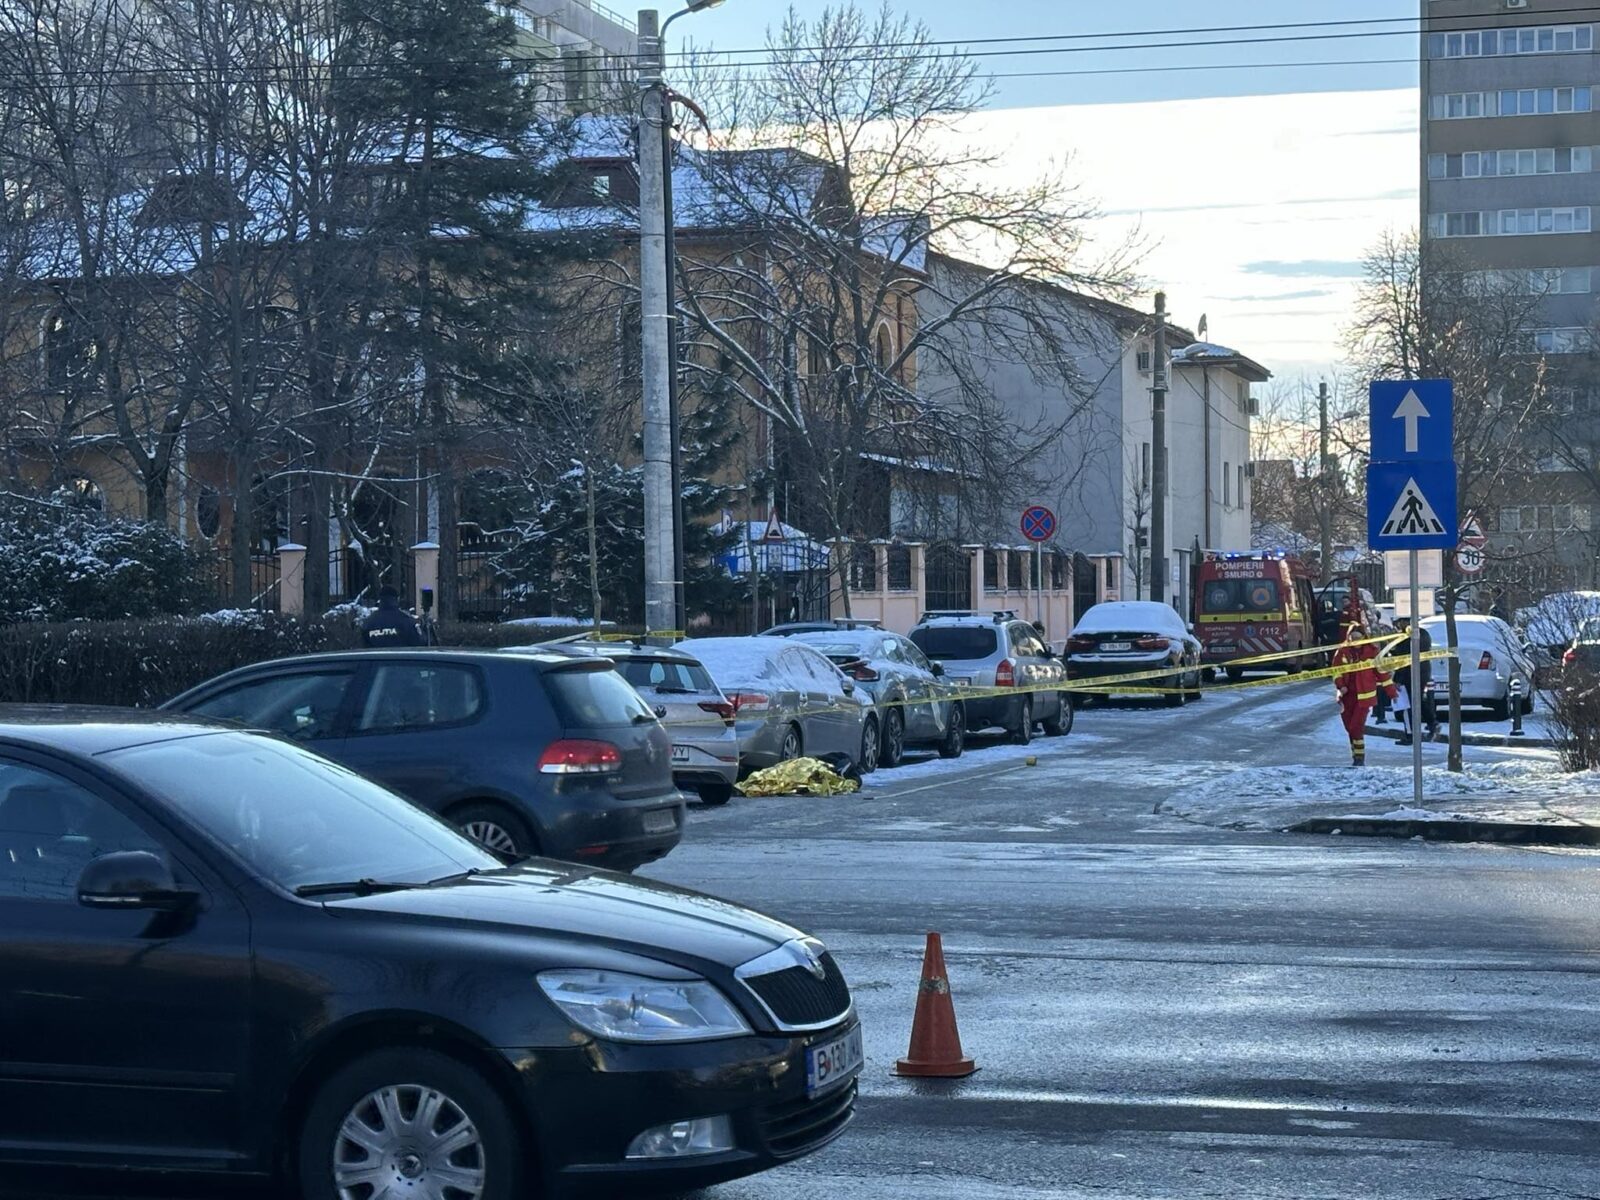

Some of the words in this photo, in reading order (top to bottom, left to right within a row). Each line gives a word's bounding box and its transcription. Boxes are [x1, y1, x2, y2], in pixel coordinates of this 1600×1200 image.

[1462, 548, 1480, 566] 30
[1224, 571, 1255, 579] SMURD
[1265, 627, 1280, 635] 112
